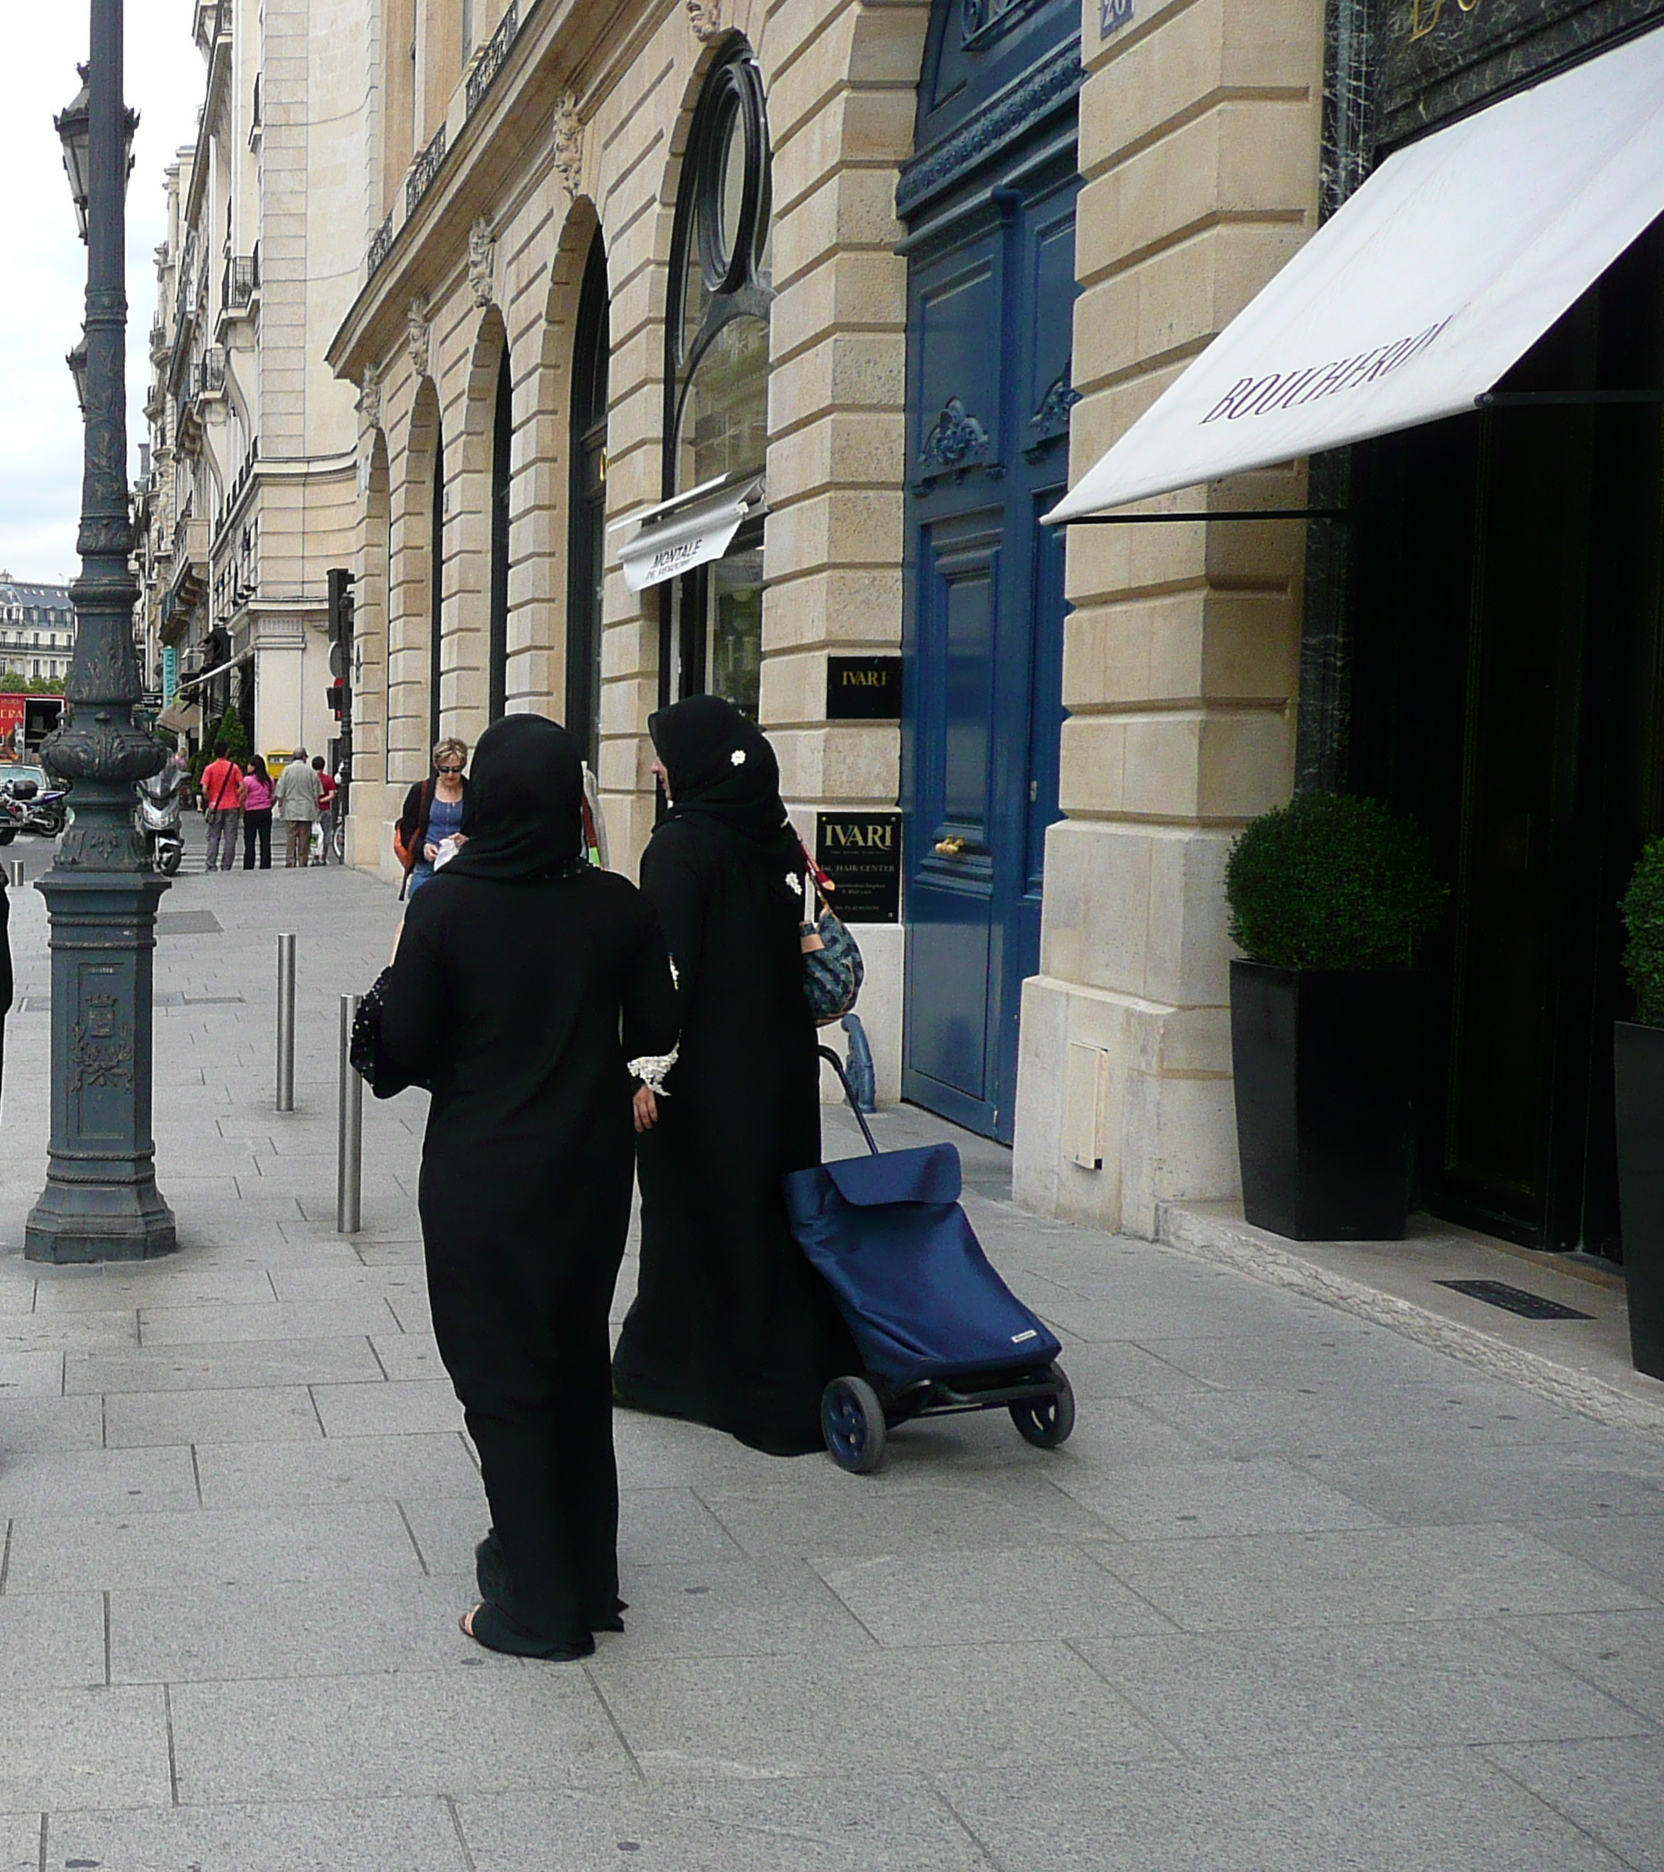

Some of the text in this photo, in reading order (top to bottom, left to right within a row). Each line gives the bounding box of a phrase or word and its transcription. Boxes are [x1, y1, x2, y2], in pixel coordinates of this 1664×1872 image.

[1199, 314, 1453, 425] BOUCHERON
[650, 539, 703, 568] MONTALE
[842, 671, 887, 687] IVARI
[824, 825, 892, 850] IVARI
